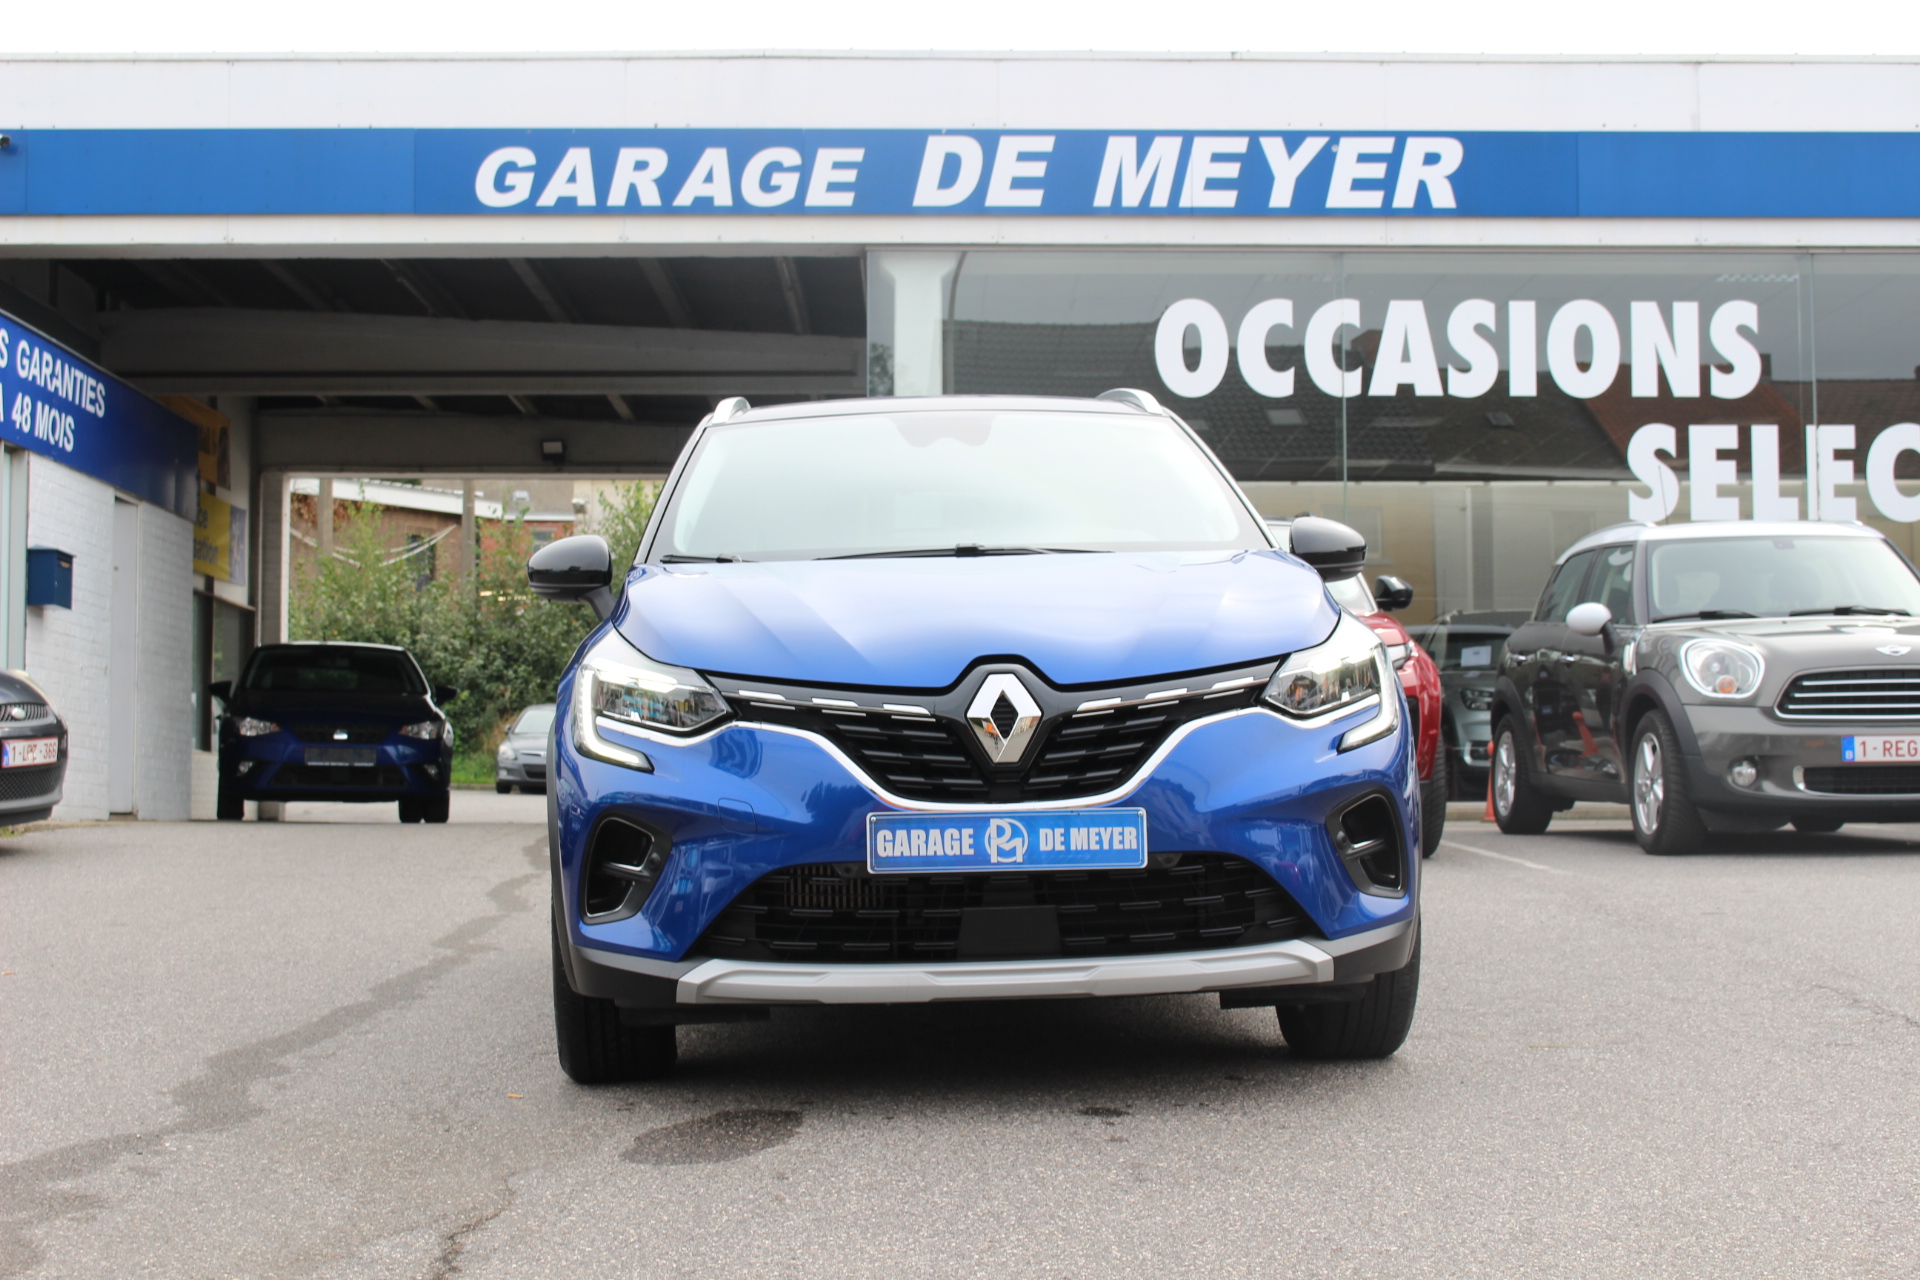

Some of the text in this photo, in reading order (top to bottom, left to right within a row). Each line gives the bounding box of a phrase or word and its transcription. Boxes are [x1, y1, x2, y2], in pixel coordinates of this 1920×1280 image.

[474, 135, 1463, 208] GARAGE DE MEYER
[16, 339, 105, 418] GARANTIES
[1154, 298, 1762, 399] OCCASIONS
[11, 392, 32, 433] 48
[34, 401, 75, 452] MOIS
[1627, 423, 1920, 523] SELEC
[876, 829, 975, 858] GARAGE
[1039, 827, 1065, 851] DE
[1070, 826, 1138, 851] MEYER
